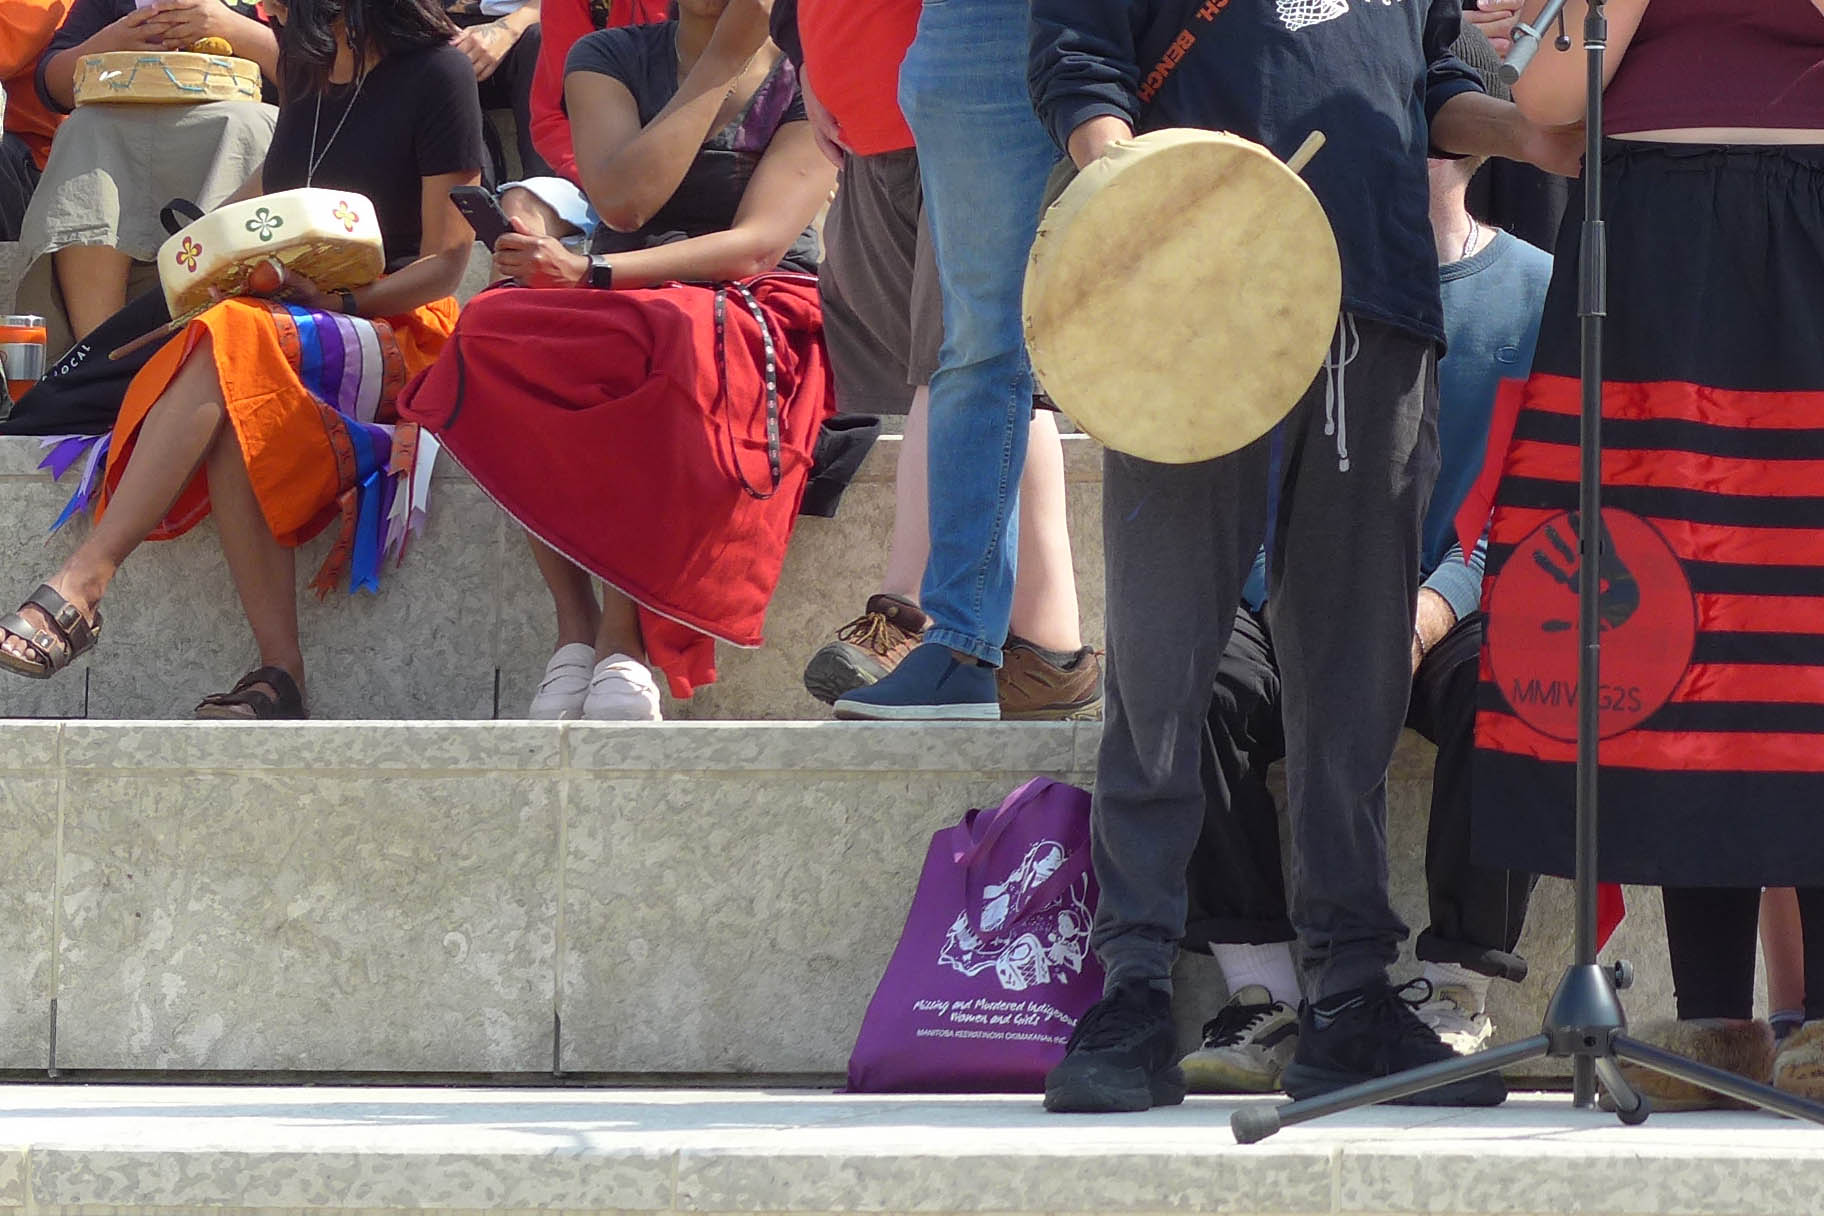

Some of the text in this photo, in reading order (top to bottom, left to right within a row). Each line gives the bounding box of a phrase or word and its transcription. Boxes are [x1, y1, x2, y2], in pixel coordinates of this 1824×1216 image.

[951, 1000, 972, 1011] and
[974, 998, 1025, 1012] Murdered
[950, 1010, 1041, 1027] Women and Girls
